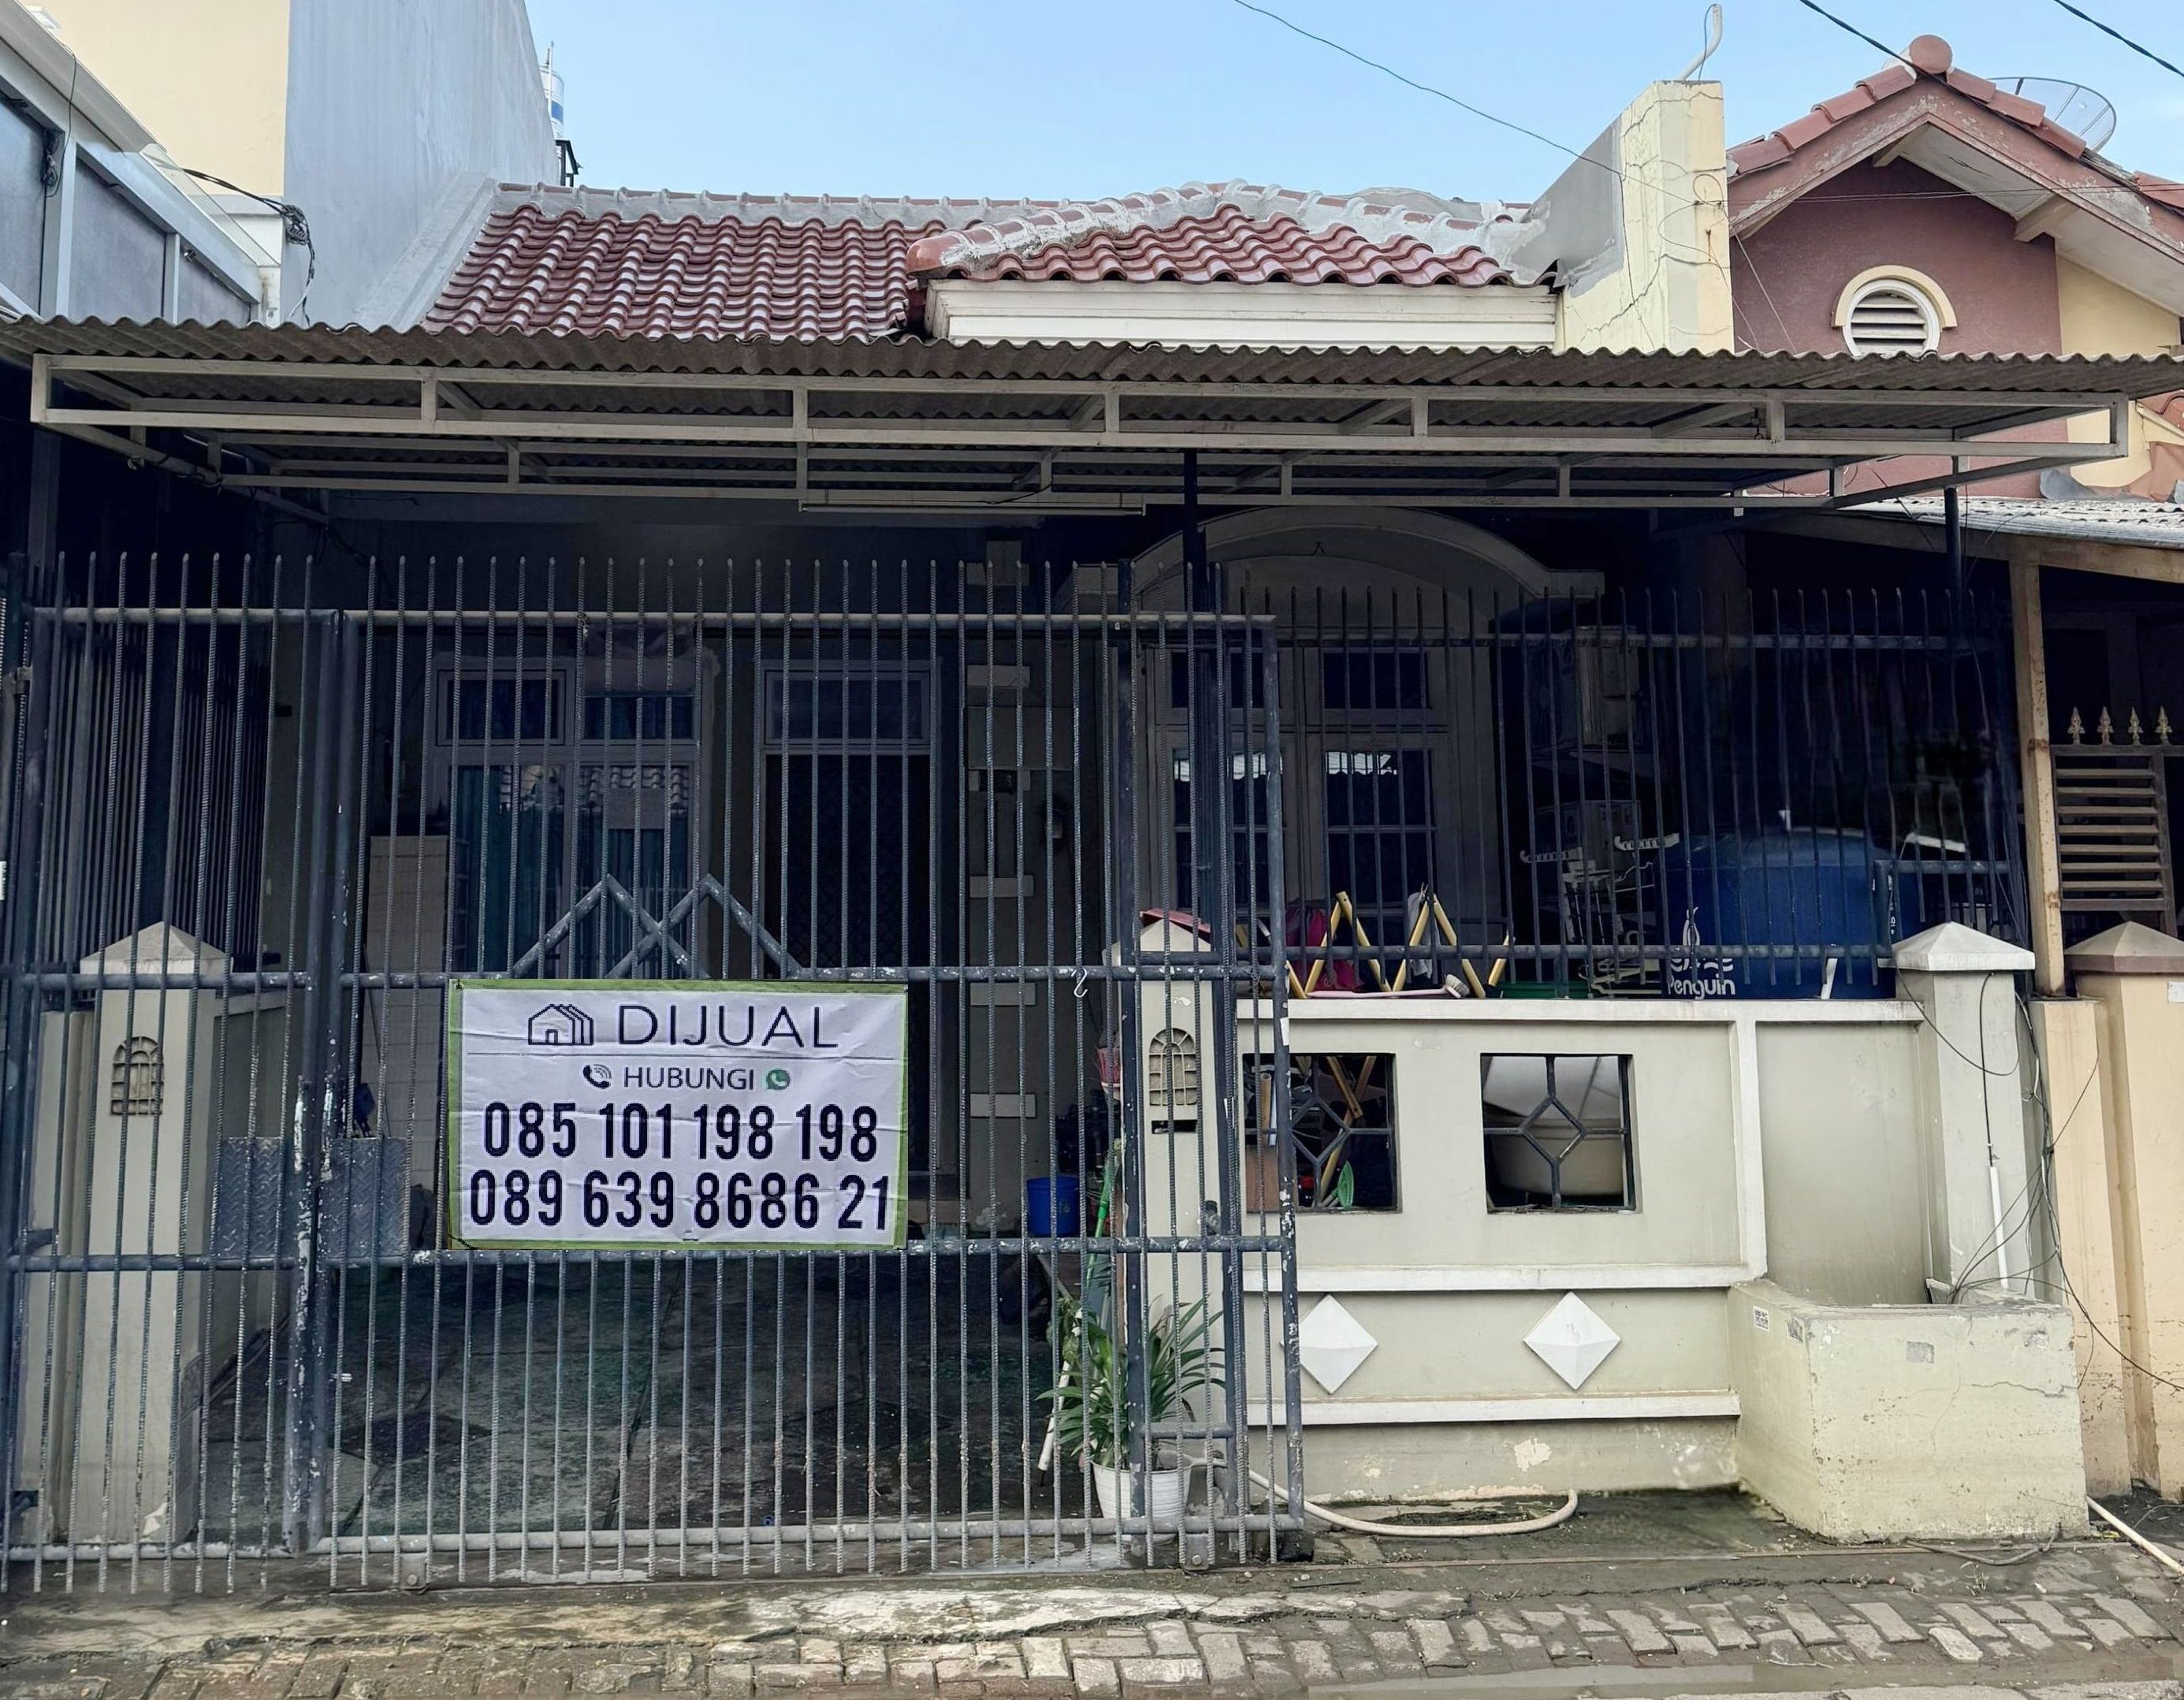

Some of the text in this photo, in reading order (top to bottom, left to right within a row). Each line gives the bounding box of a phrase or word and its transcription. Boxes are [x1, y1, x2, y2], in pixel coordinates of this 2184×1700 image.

[619, 1005, 839, 1048] DIJUAL
[623, 1066, 754, 1091] HUBUNGI
[484, 1102, 876, 1162] 085 101 198 198
[472, 1170, 888, 1230] 089 639 8686 21
